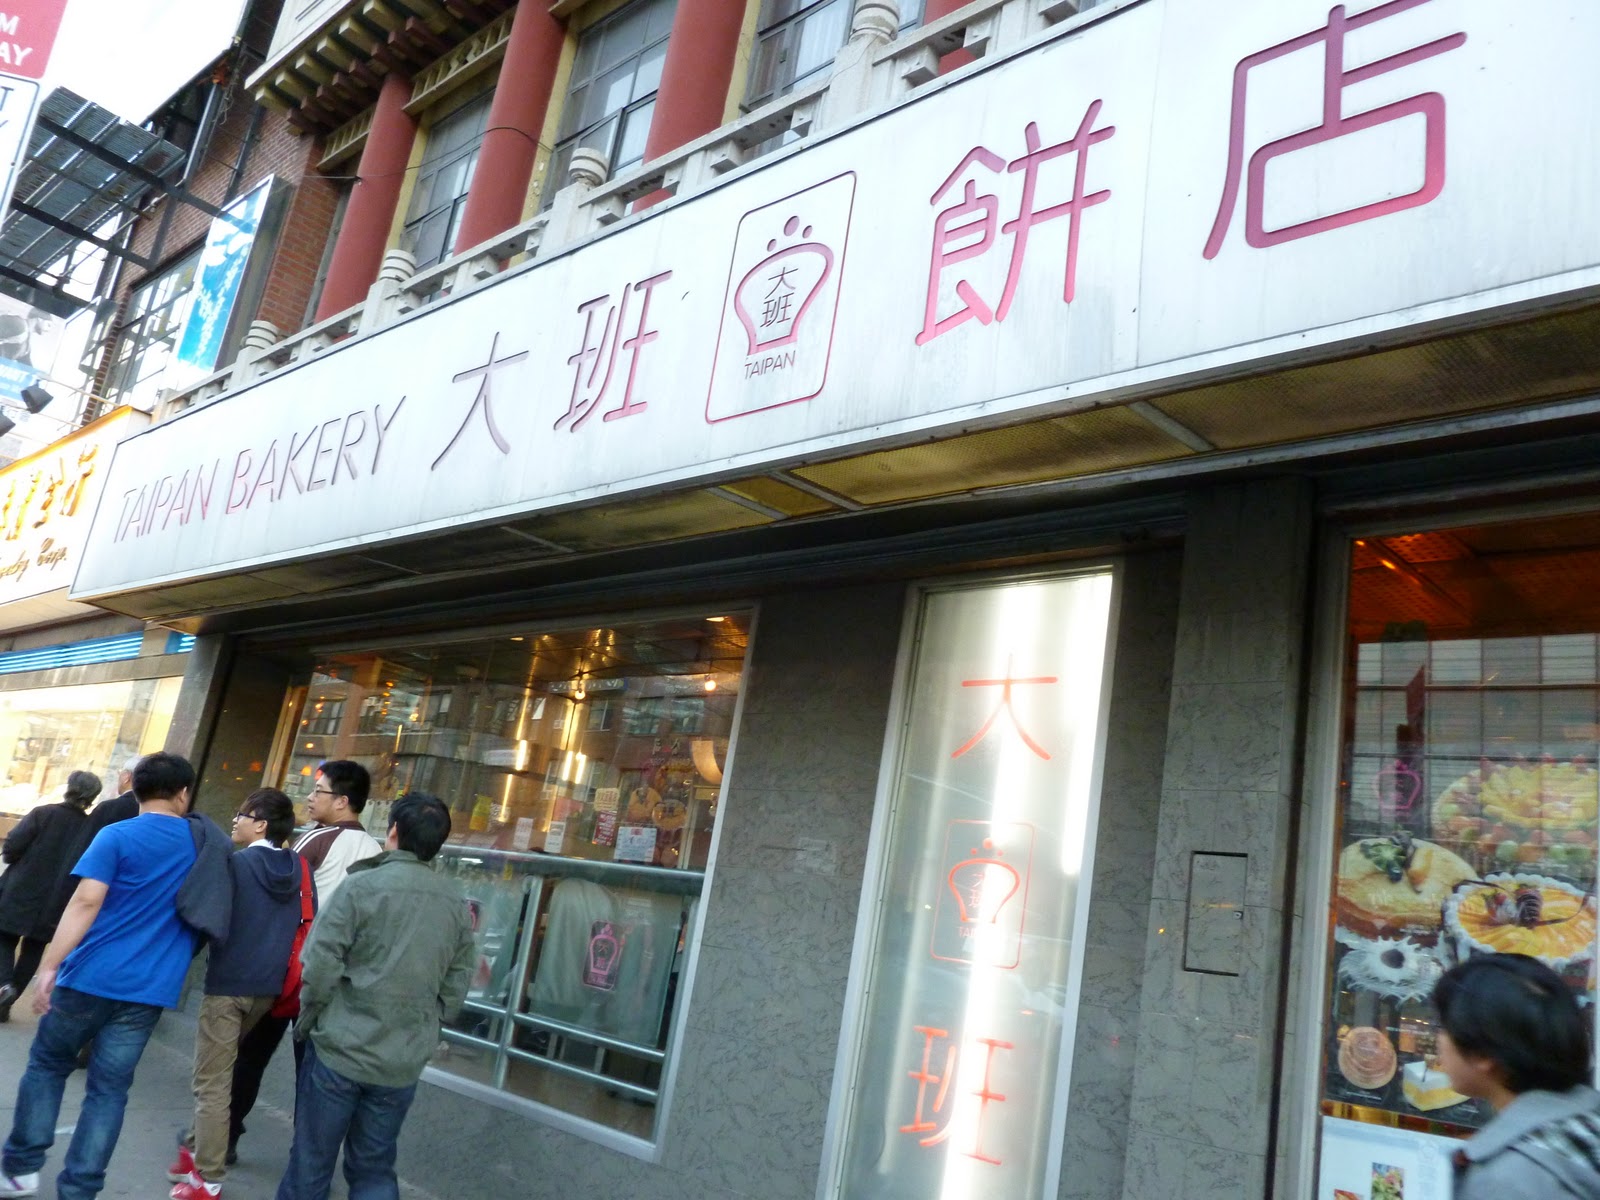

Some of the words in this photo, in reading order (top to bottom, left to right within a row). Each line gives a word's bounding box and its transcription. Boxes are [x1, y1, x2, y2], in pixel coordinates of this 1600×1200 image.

[431, 270, 672, 471] 大班
[744, 350, 796, 380] TAIPAN
[114, 458, 220, 543] TAIPAN
[226, 395, 406, 515] BAKERY
